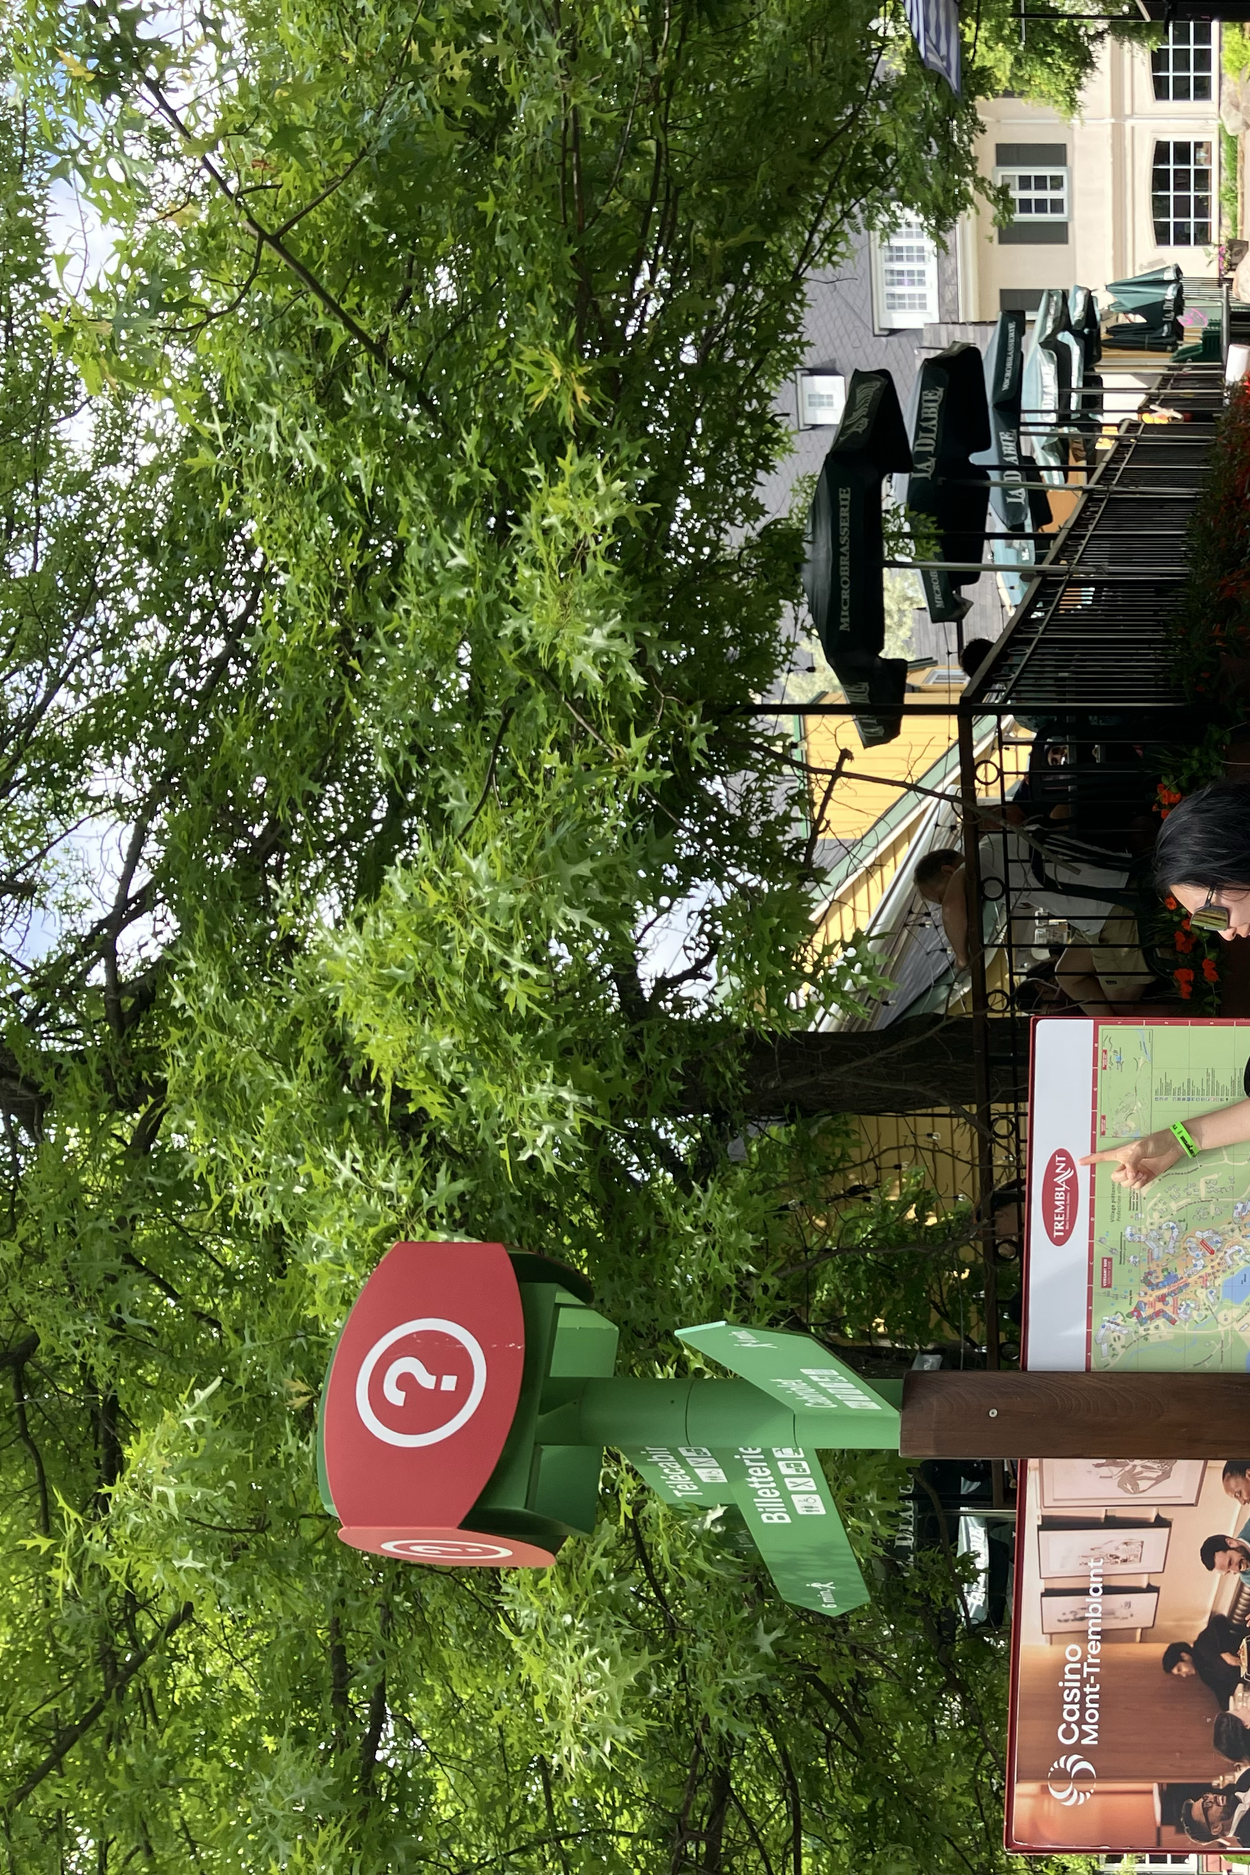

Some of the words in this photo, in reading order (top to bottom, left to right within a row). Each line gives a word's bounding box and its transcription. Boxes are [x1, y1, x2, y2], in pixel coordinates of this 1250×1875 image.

[1002, 321, 1016, 391] MICROBRASSERIE
[913, 386, 944, 454] DIABLE
[910, 456, 937, 480] LA
[999, 429, 1022, 483] DABLE
[1006, 488, 1026, 504] LA
[838, 487, 852, 632] MICROBRASSERIE
[1053, 1154, 1074, 1238] TREMBLANT
[770, 1378, 838, 1408] Cabriolet
[816, 1588, 836, 1603] min.
[1081, 1558, 1104, 1745] Mont-Tremblant
[1057, 1644, 1082, 1745] Casino
